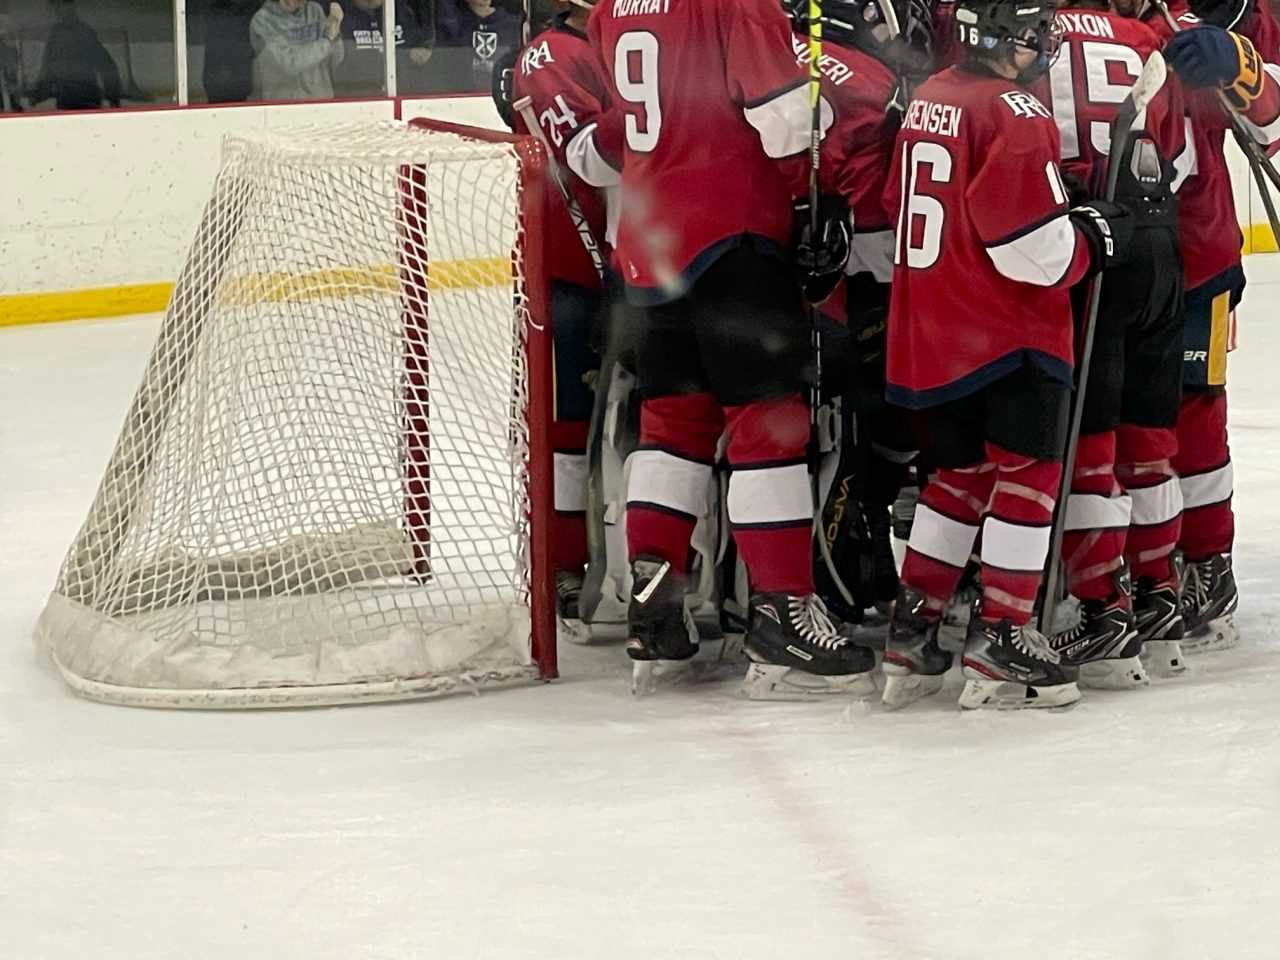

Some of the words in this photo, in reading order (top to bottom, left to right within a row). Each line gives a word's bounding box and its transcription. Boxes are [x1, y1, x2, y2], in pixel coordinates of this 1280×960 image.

[959, 25, 979, 45] 16
[539, 94, 578, 148] 24
[615, 31, 662, 153] 9
[894, 140, 952, 269] 16
